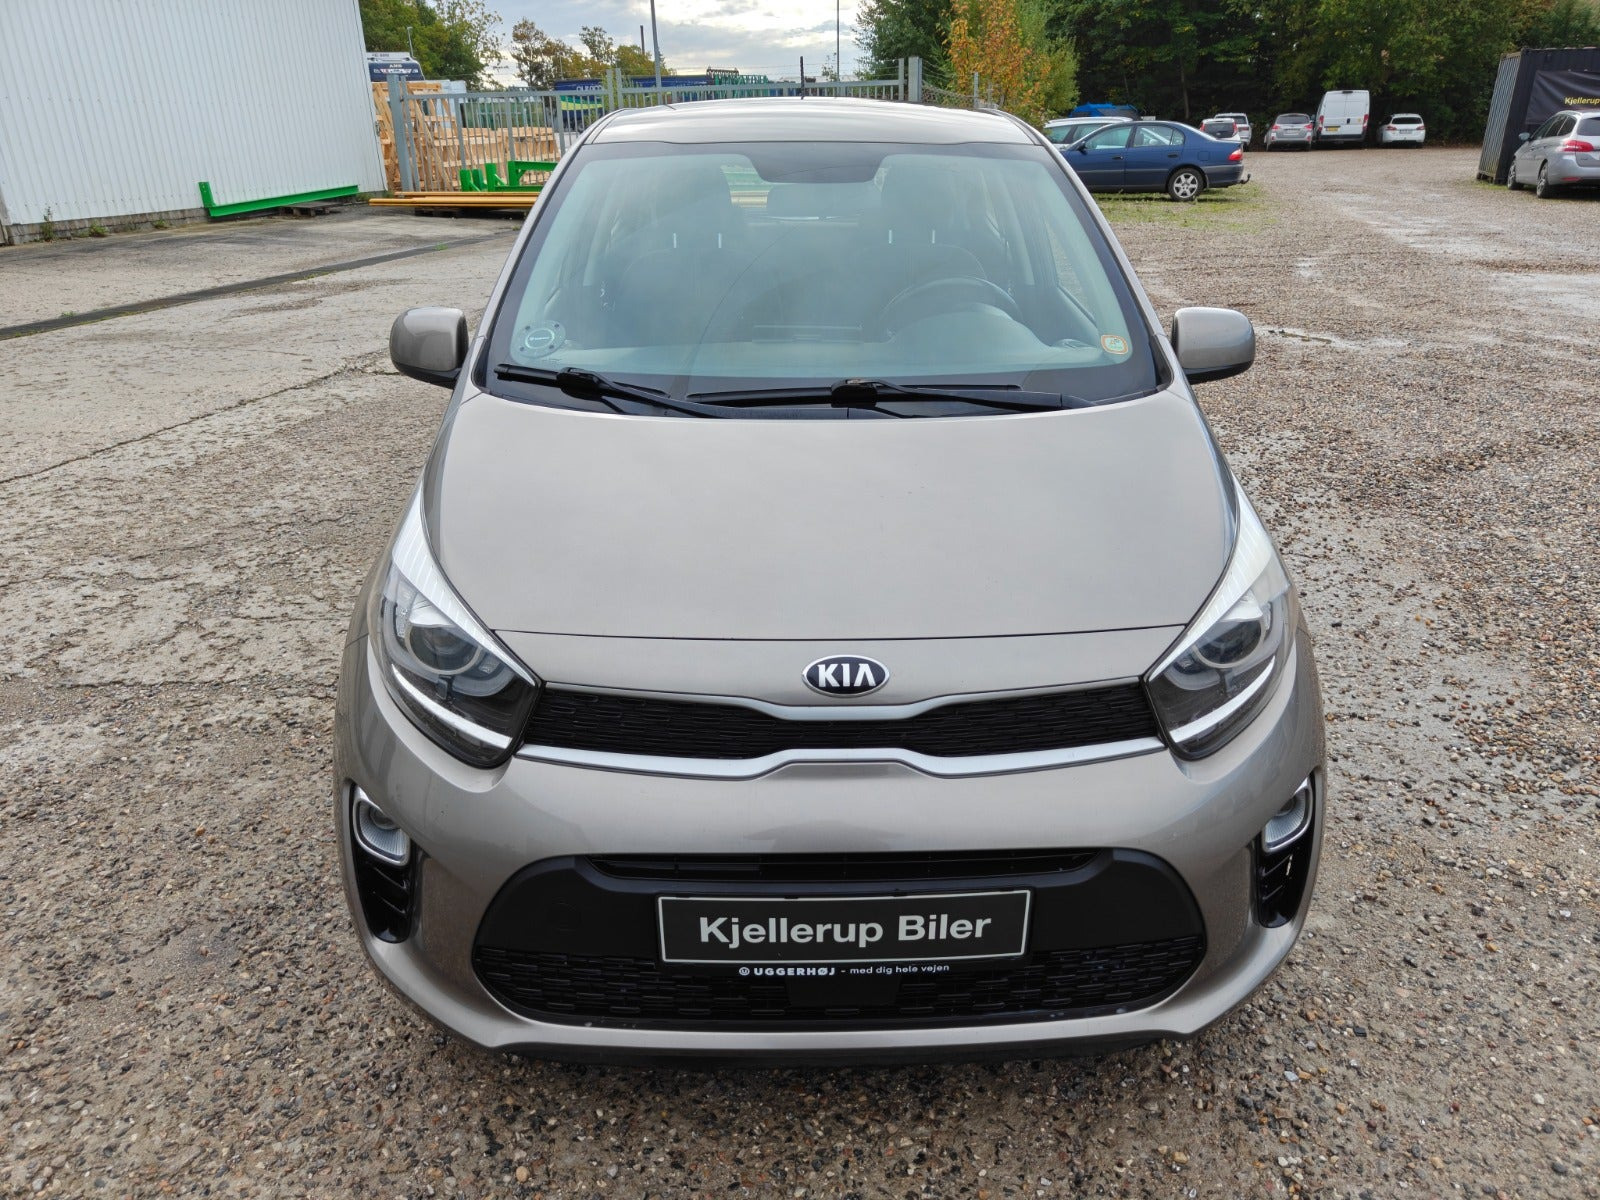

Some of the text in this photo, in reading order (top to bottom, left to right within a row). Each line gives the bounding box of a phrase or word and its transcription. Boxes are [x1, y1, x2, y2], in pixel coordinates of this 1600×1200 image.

[1564, 97, 1600, 105] Kjellerup
[817, 663, 876, 687] KIA
[699, 914, 992, 949] Kjellerup Biler
[753, 967, 835, 976] UGGERHØJ
[849, 966, 873, 974] med
[875, 966, 893, 975] dig
[895, 965, 918, 973] hele
[921, 964, 950, 973] vejen
